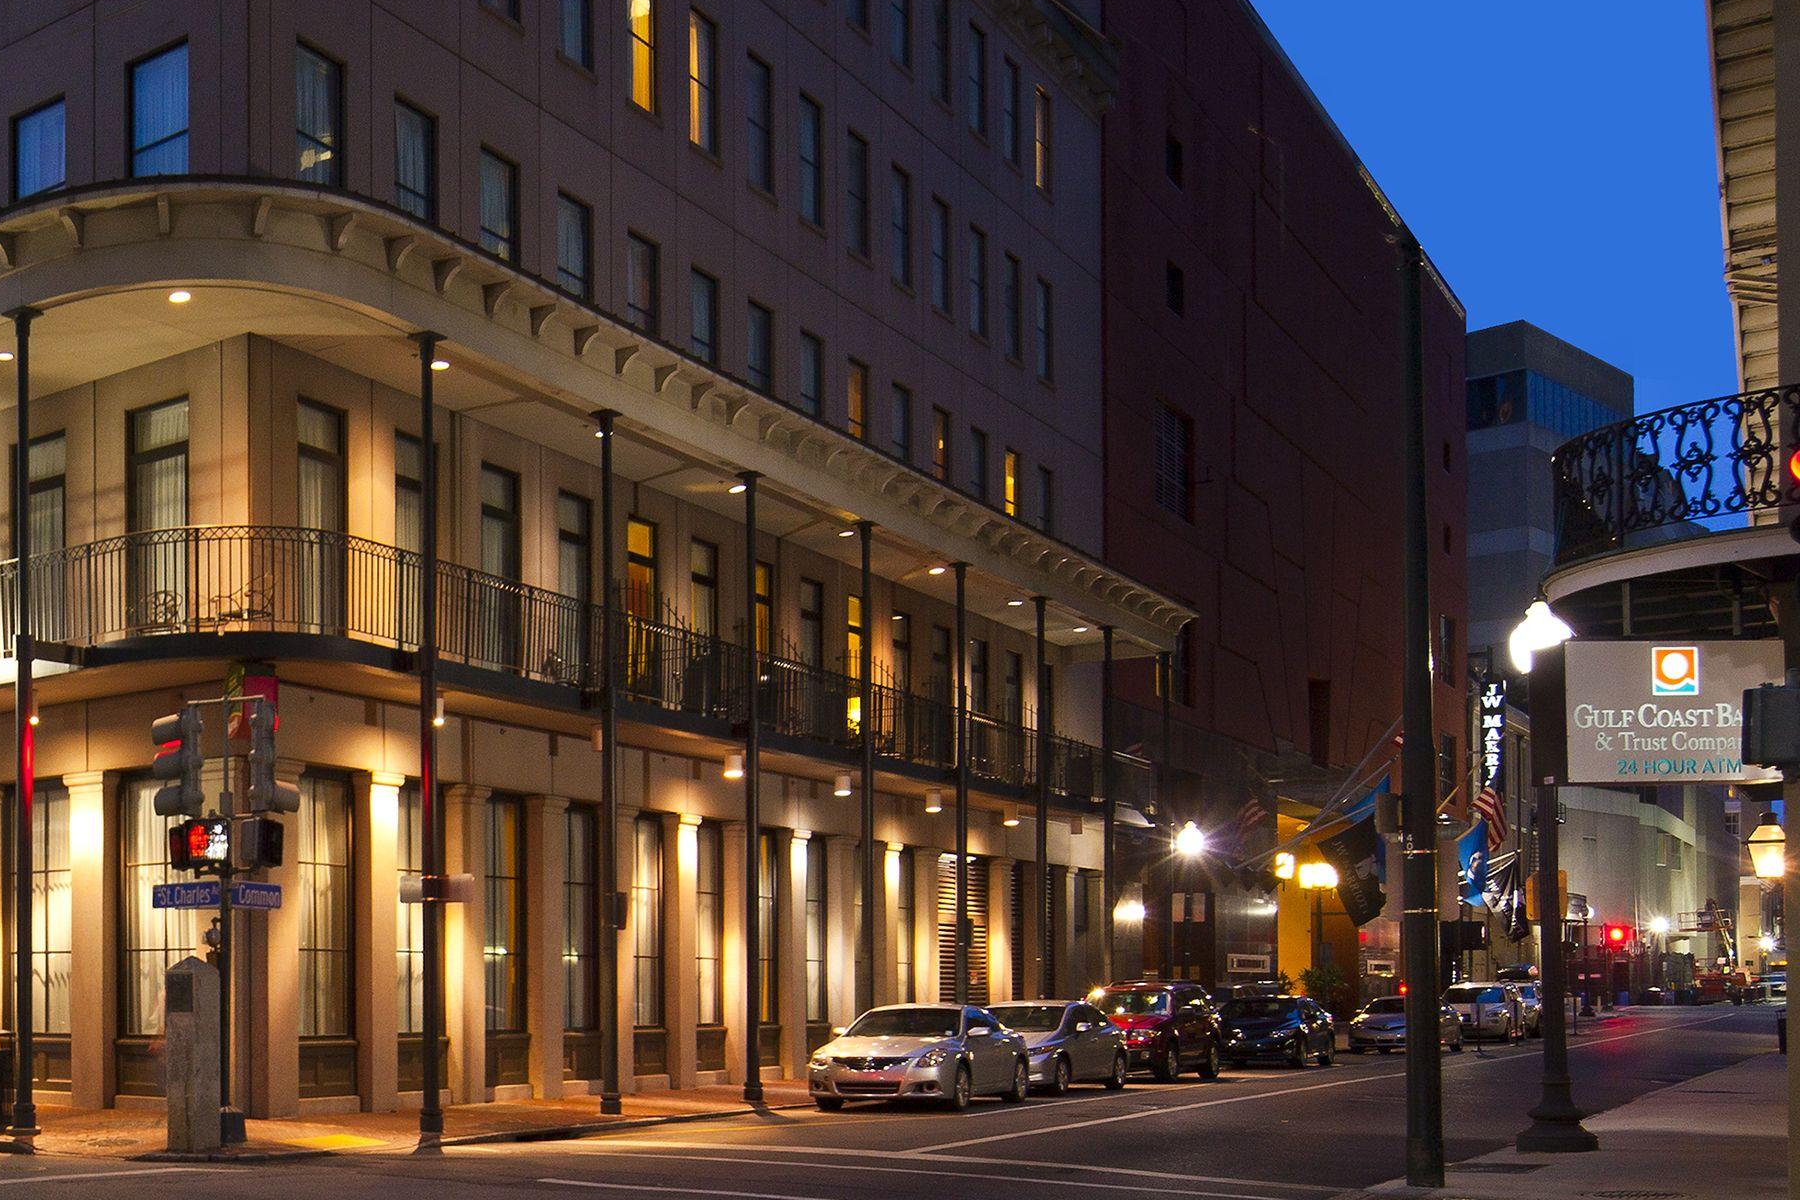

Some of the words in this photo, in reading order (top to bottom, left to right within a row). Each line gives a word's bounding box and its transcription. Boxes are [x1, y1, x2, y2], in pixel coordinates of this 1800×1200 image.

[1573, 703, 1635, 728] GULF
[1637, 703, 1714, 728] COAST
[1715, 703, 1742, 728] BA
[1482, 714, 1502, 787] MARRI
[1595, 731, 1613, 751] &
[1617, 731, 1668, 751] Trust
[1671, 731, 1742, 755] Compa
[1615, 759, 1638, 775] 24
[1643, 759, 1697, 775] HOUR
[1701, 759, 1742, 774] ATM
[174, 885, 210, 904] Charles
[239, 883, 280, 907] Common
